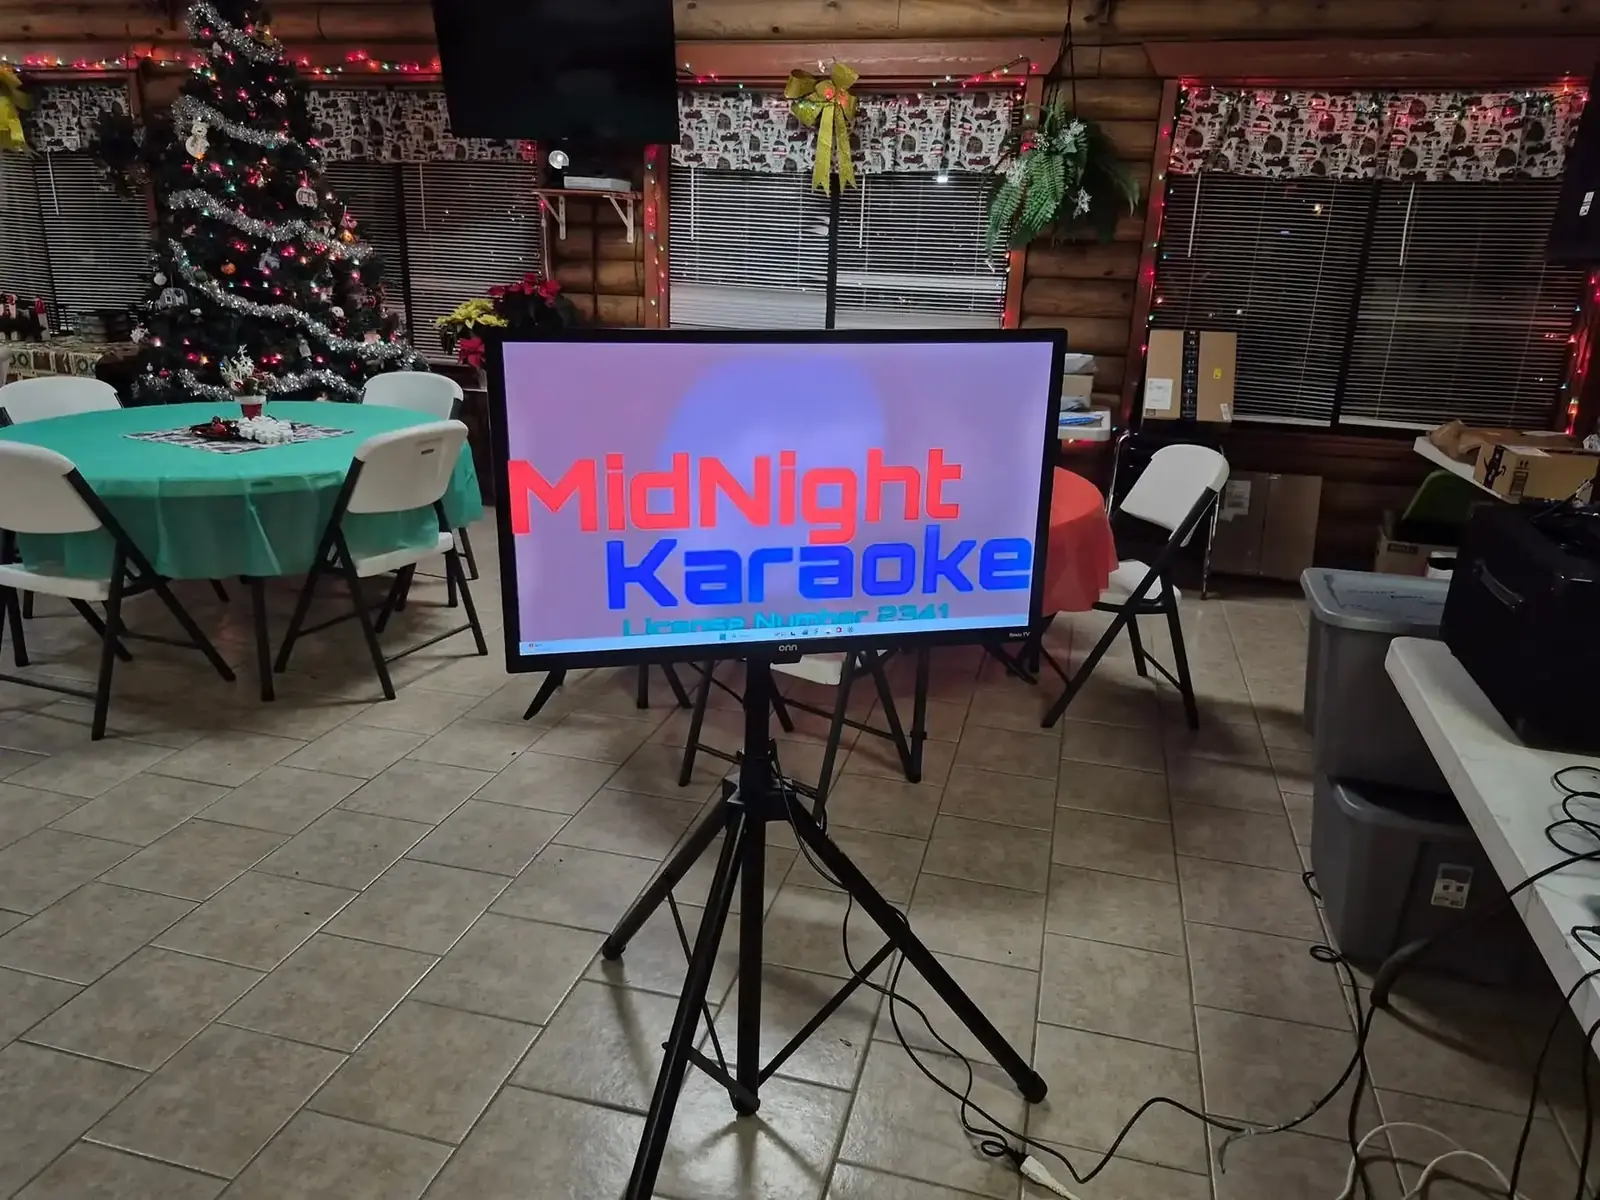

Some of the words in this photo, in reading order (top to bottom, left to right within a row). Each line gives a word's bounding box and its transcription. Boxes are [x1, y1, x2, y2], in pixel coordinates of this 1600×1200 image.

[507, 447, 963, 545] MidNight
[606, 523, 1031, 610] Karaoke
[754, 608, 869, 629] Number
[877, 603, 950, 622] 2341
